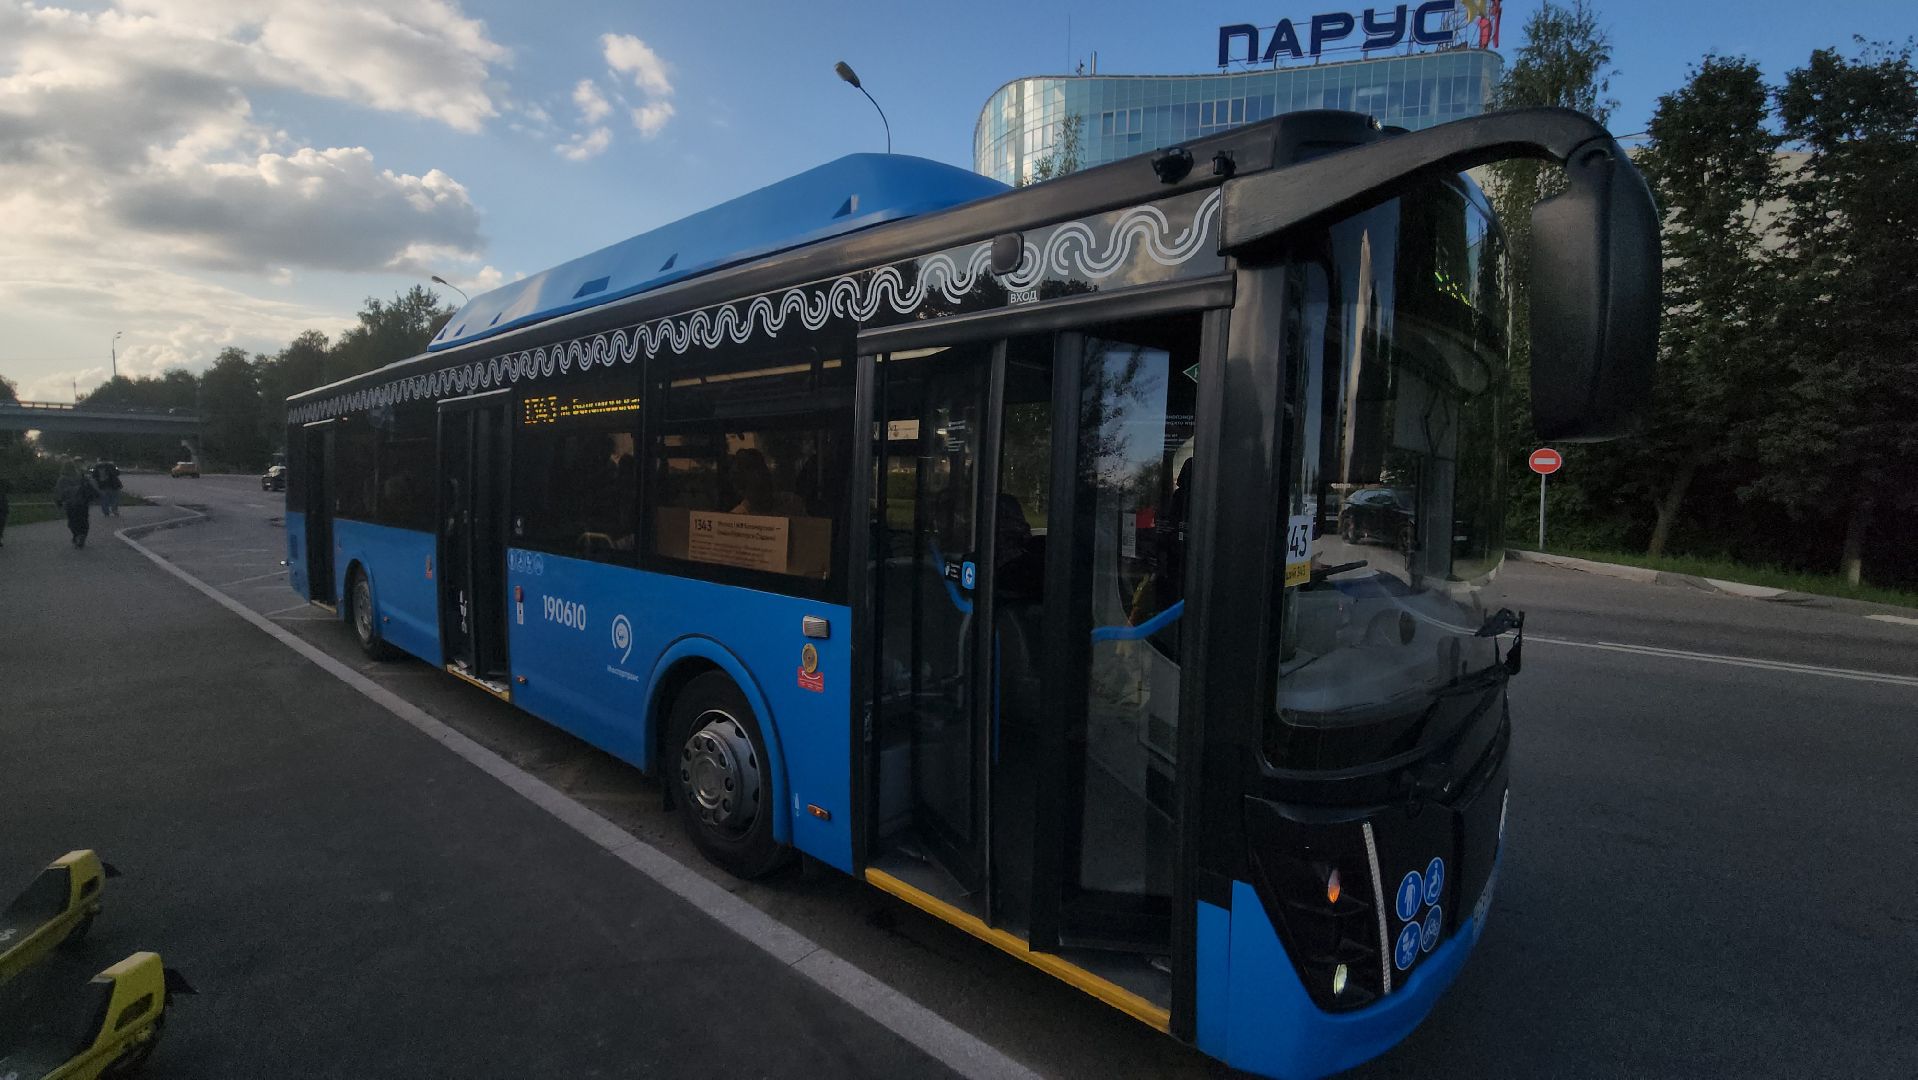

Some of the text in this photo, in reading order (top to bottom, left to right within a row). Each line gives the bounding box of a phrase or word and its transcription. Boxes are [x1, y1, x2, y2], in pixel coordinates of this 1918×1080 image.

[1217, 0, 1455, 67] ПАРУС
[1010, 290, 1038, 304] ВХОД
[694, 519, 712, 531] 1343
[542, 594, 586, 631] 190610
